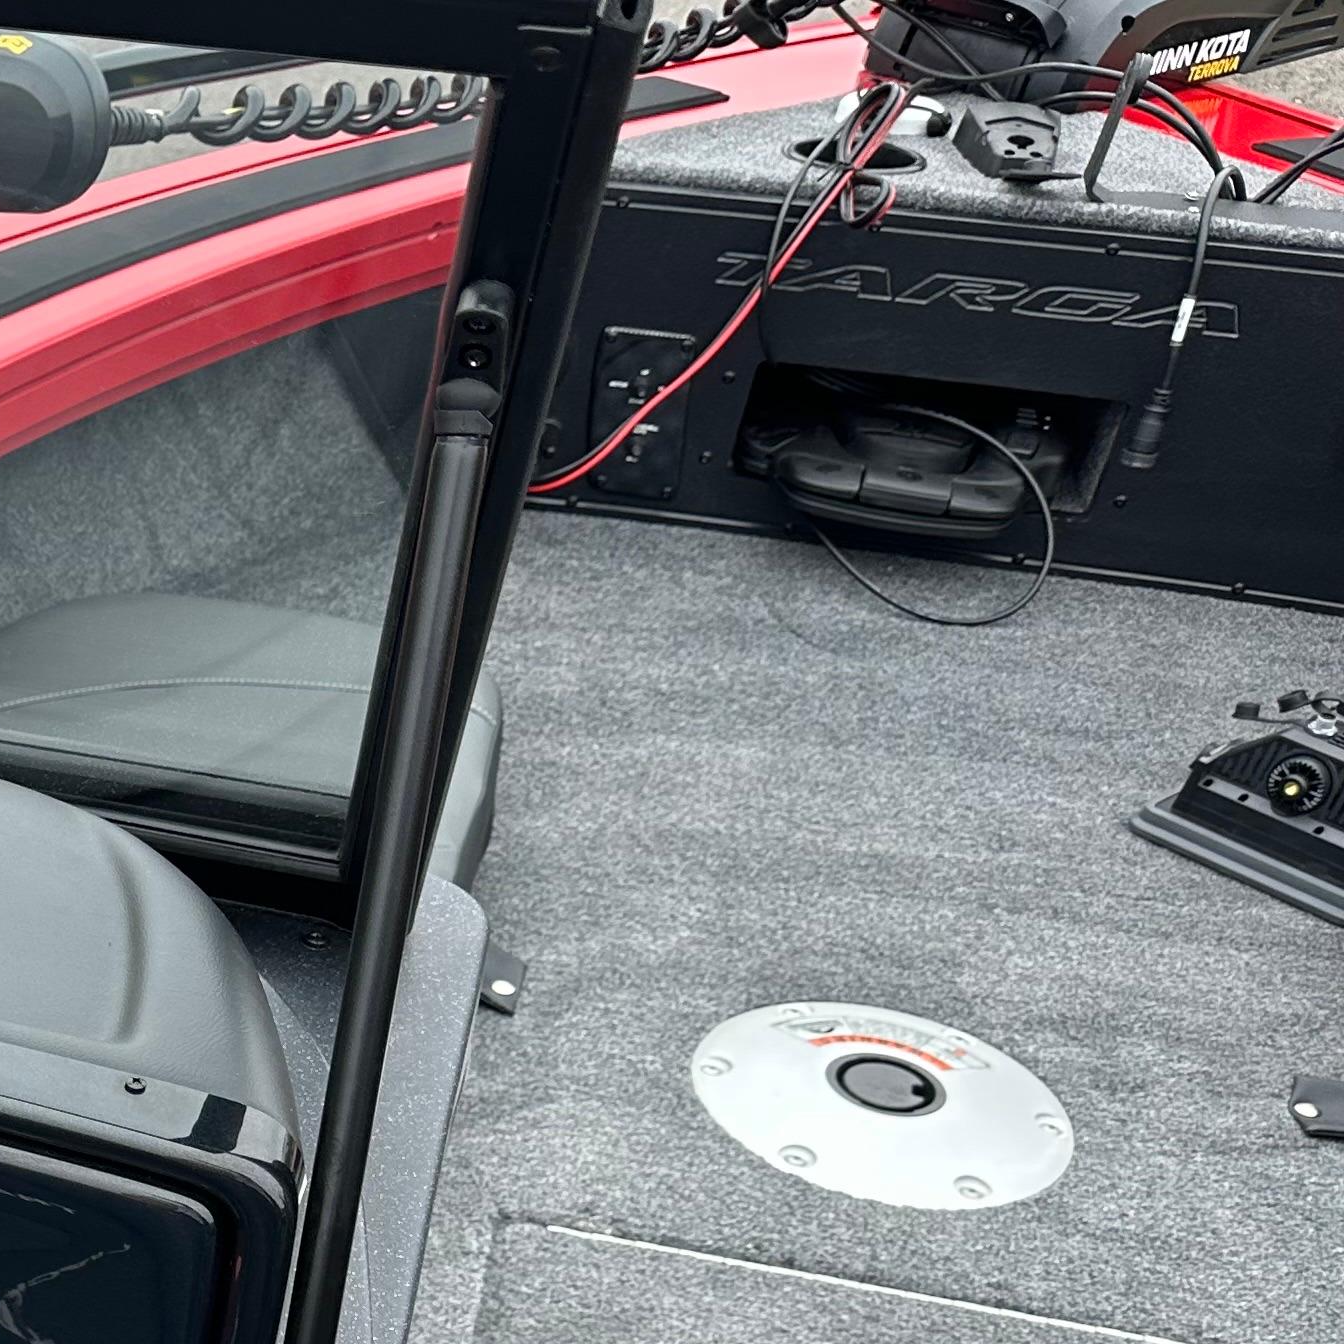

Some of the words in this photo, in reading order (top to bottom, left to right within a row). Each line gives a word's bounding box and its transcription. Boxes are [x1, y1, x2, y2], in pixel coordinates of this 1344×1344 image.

[1194, 28, 1251, 63] KOTA
[1187, 55, 1240, 82] TERROVA
[714, 251, 1240, 338] TARGA
